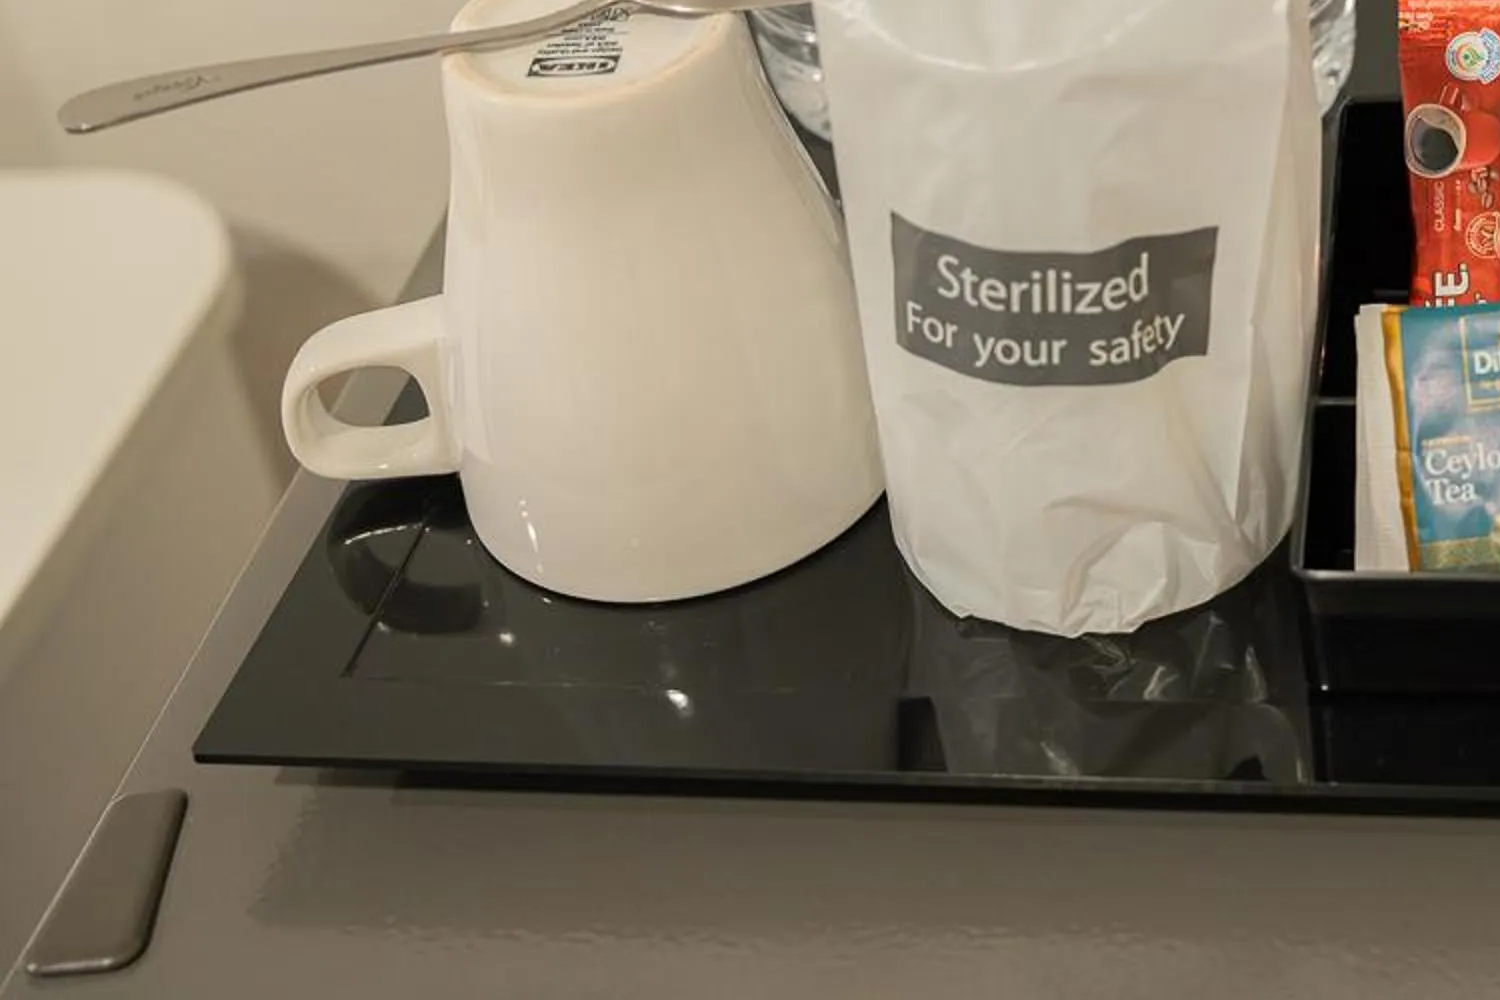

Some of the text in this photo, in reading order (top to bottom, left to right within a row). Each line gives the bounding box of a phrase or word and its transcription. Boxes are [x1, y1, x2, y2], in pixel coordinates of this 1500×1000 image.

[1433, 181, 1446, 232] CLASSIC
[936, 251, 1150, 314] Sterilized
[905, 300, 1186, 368] For your safety
[1425, 478, 1478, 506] Tea
